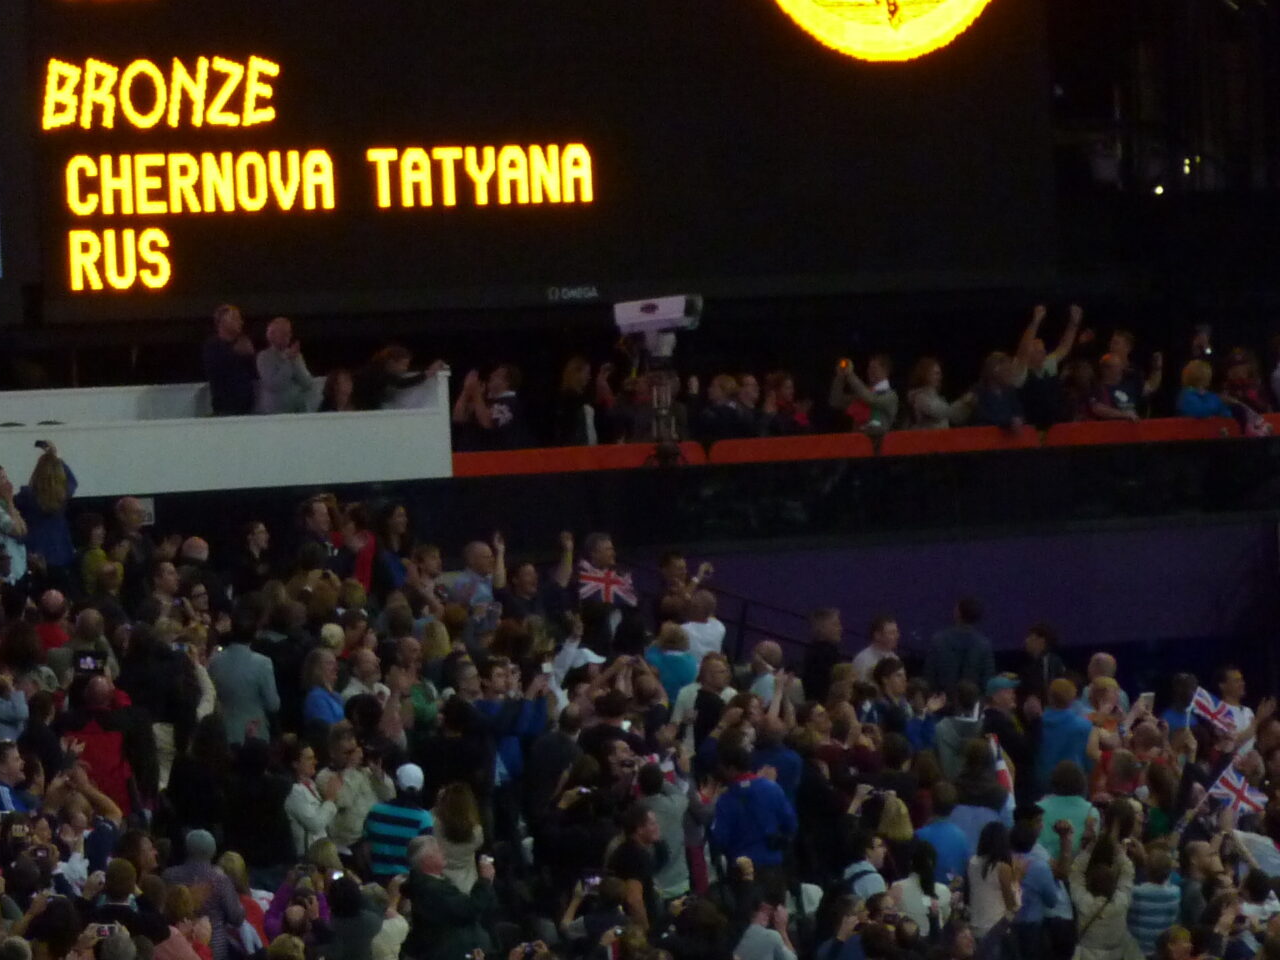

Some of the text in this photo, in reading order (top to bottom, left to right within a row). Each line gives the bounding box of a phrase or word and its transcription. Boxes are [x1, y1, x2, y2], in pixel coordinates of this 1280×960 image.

[41, 55, 280, 131] BRONZE
[65, 143, 594, 217] CHERNOVA TATYANA
[68, 227, 172, 291] RUS
